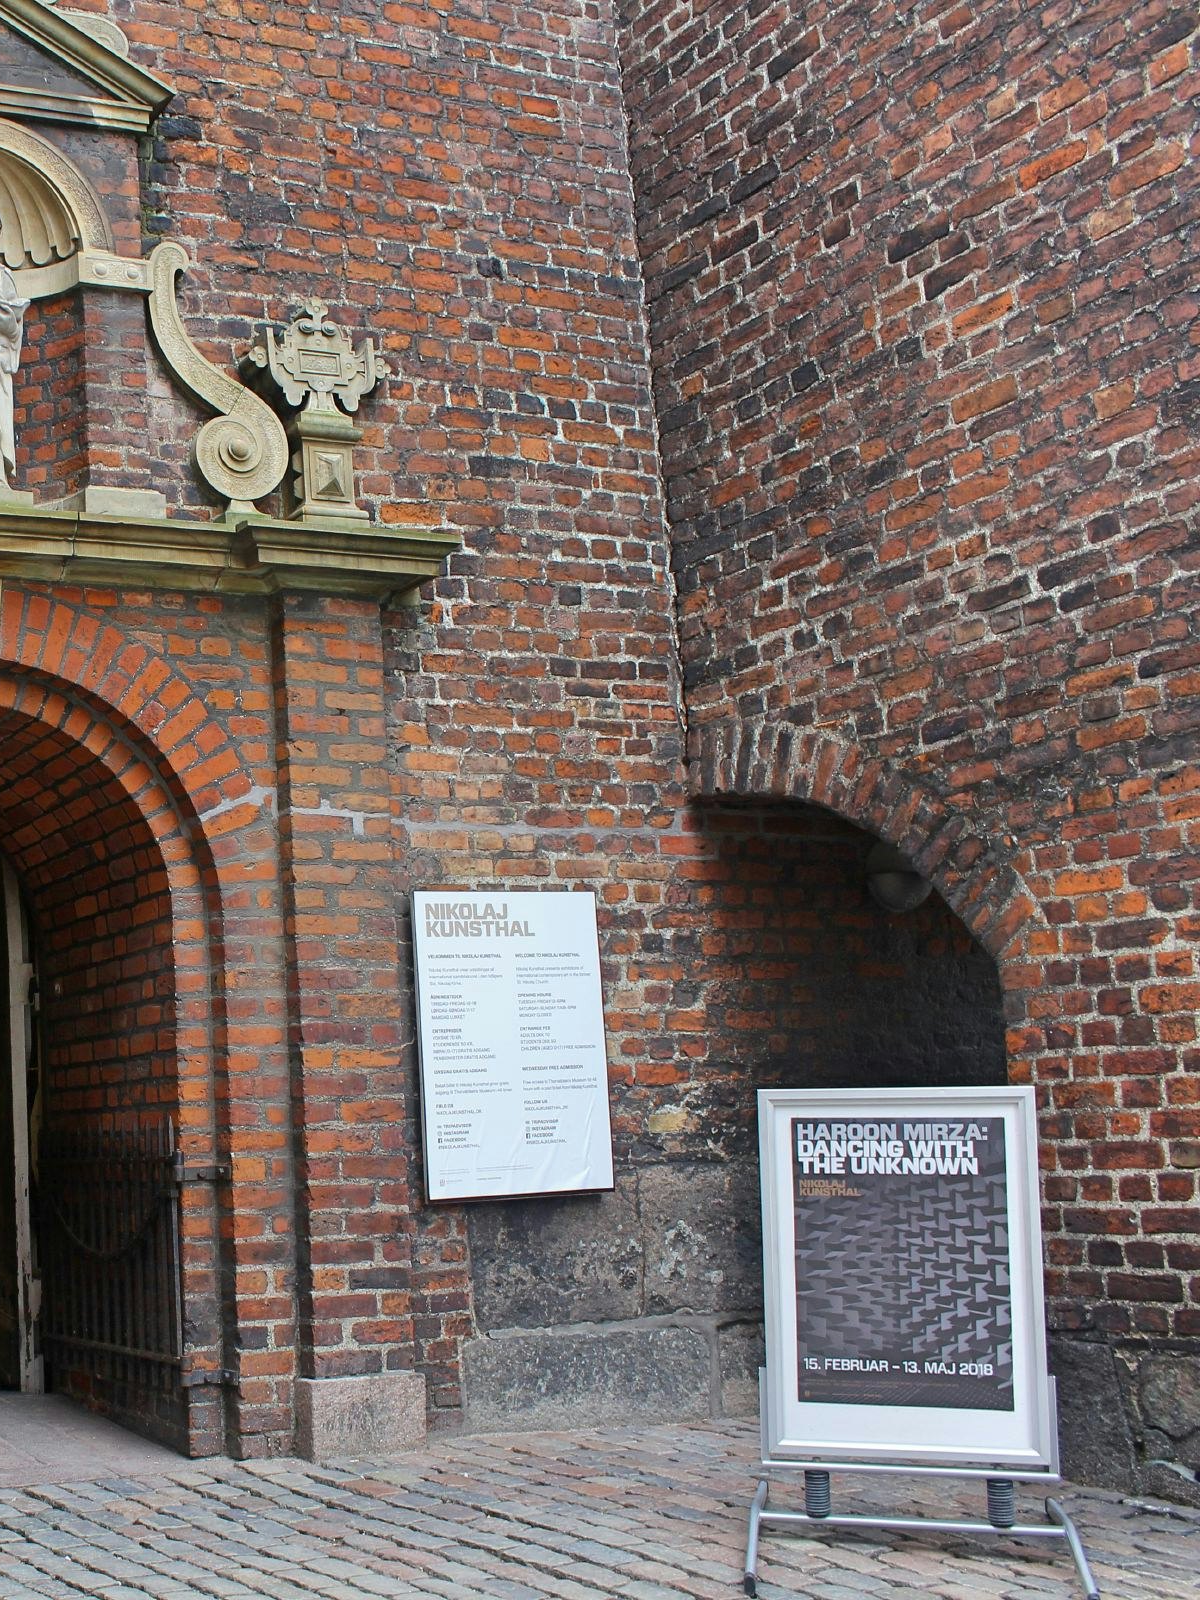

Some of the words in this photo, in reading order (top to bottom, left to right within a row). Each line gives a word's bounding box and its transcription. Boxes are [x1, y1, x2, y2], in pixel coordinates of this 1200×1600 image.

[424, 903, 508, 920] NIKOLAJ
[425, 920, 536, 937] KUNSTHAL
[796, 1124, 897, 1141] HAROON
[903, 1123, 988, 1141] MIRZA:
[798, 1140, 904, 1158] DANCING
[909, 1140, 974, 1158] WITH
[798, 1157, 846, 1175] THE
[851, 1157, 979, 1176] UNKNOWN
[800, 1179, 846, 1188] NIKOLAJ
[800, 1187, 861, 1197] KUNSTHAL
[803, 1357, 821, 1370] 15.
[824, 1358, 889, 1373] FEBRUAR
[902, 1361, 921, 1374] 13.
[924, 1361, 956, 1375] MAJ
[959, 1363, 994, 1377] 2018
